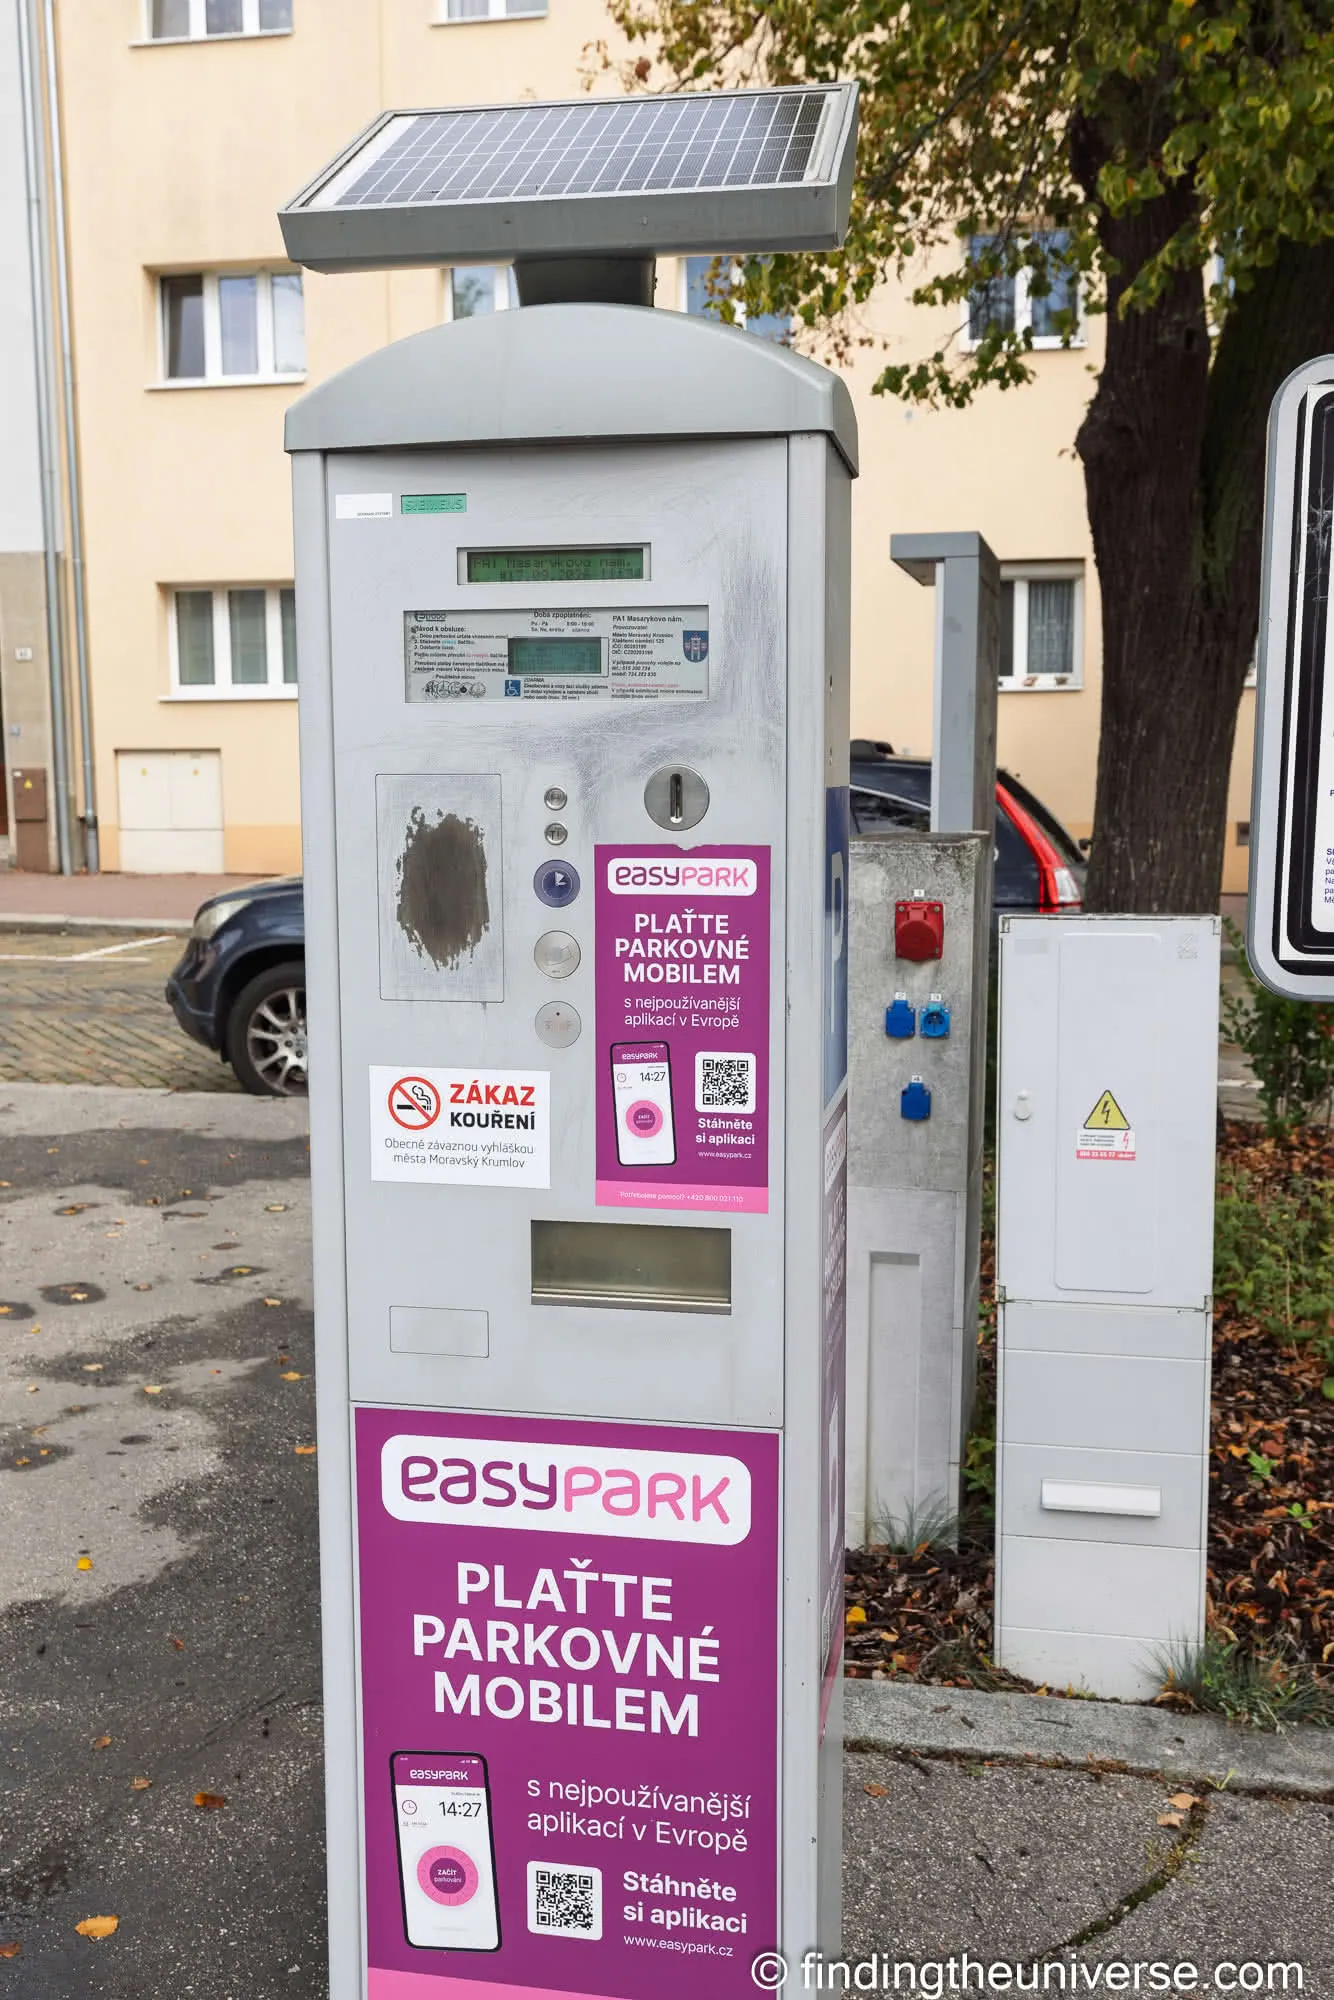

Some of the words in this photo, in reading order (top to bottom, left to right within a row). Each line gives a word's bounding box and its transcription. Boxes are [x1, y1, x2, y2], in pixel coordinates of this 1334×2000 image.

[635, 909, 729, 934] PLAŤTE
[615, 934, 749, 960] PARKOVNÉ
[624, 963, 740, 985] MOBILEM
[624, 998, 632, 1009] s
[635, 996, 741, 1013] nejpoužívanější
[624, 1012, 676, 1028] aplikací
[679, 1016, 688, 1026] v
[691, 1013, 740, 1030] Evropě
[640, 1071, 666, 1082] 14:27
[450, 1080, 535, 1106] ZÁKAZ
[450, 1110, 535, 1130] KOUŘENÍ
[697, 1117, 753, 1130] Stáhněte
[384, 1137, 425, 1150] Obecně
[427, 1139, 478, 1152] závaznou
[480, 1142, 534, 1155] vyhláškou
[695, 1133, 706, 1144] si
[709, 1133, 755, 1146] aplikaci
[393, 1152, 426, 1164] města
[429, 1153, 479, 1168] Moravský
[482, 1156, 525, 1168] Krumlov
[457, 1558, 673, 1621] PLAŤTE
[412, 1613, 720, 1683] PARKOVNÉ
[434, 1671, 699, 1737] MOBILEM
[439, 1801, 482, 1817] 14:27
[527, 1779, 541, 1797] s
[549, 1779, 751, 1822] nejpoužívanější
[527, 1810, 625, 1839] aplikací
[631, 1823, 647, 1841] v
[655, 1820, 748, 1855] Evropě
[623, 1871, 737, 1902] Stáhněte
[623, 1901, 644, 1922] si
[650, 1906, 748, 1934] aplikaci
[623, 1935, 734, 1957] www.easypark.cz
